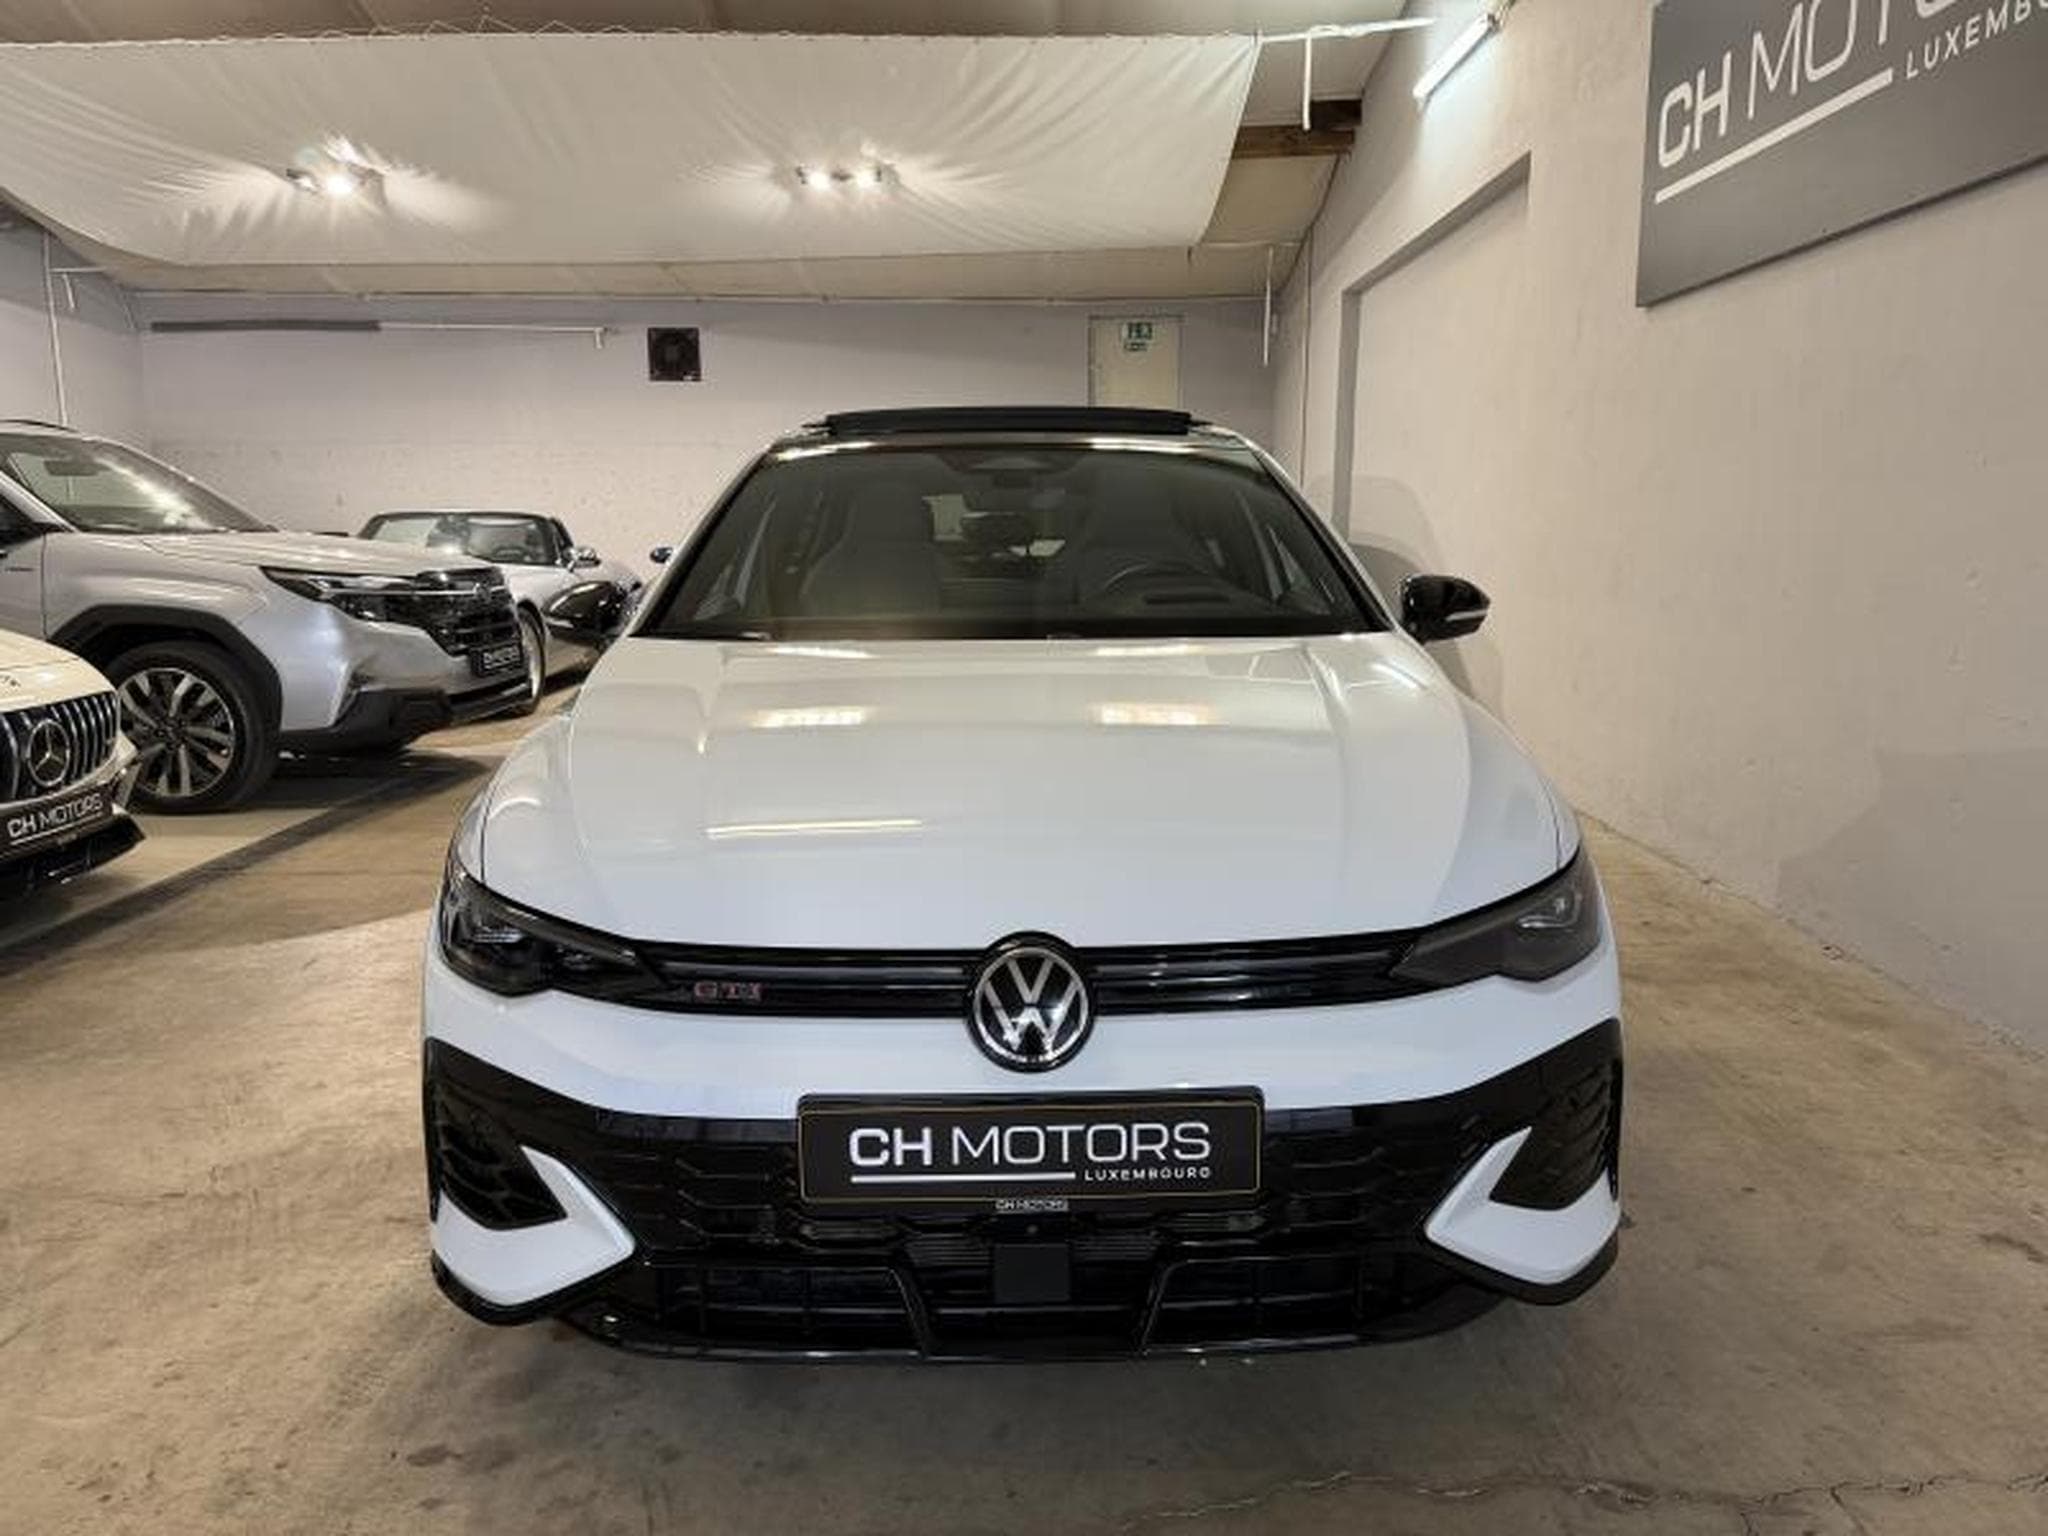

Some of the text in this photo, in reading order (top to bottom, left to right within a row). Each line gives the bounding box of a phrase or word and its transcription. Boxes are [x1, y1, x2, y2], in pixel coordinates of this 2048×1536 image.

[1906, 0, 2048, 79] LUXEMB
[1657, 0, 1958, 168] CH MO
[7, 813, 38, 838] CH
[849, 1122, 1211, 1166] CH MOTORS
[1084, 1167, 1212, 1181] LUXEMBOURG
